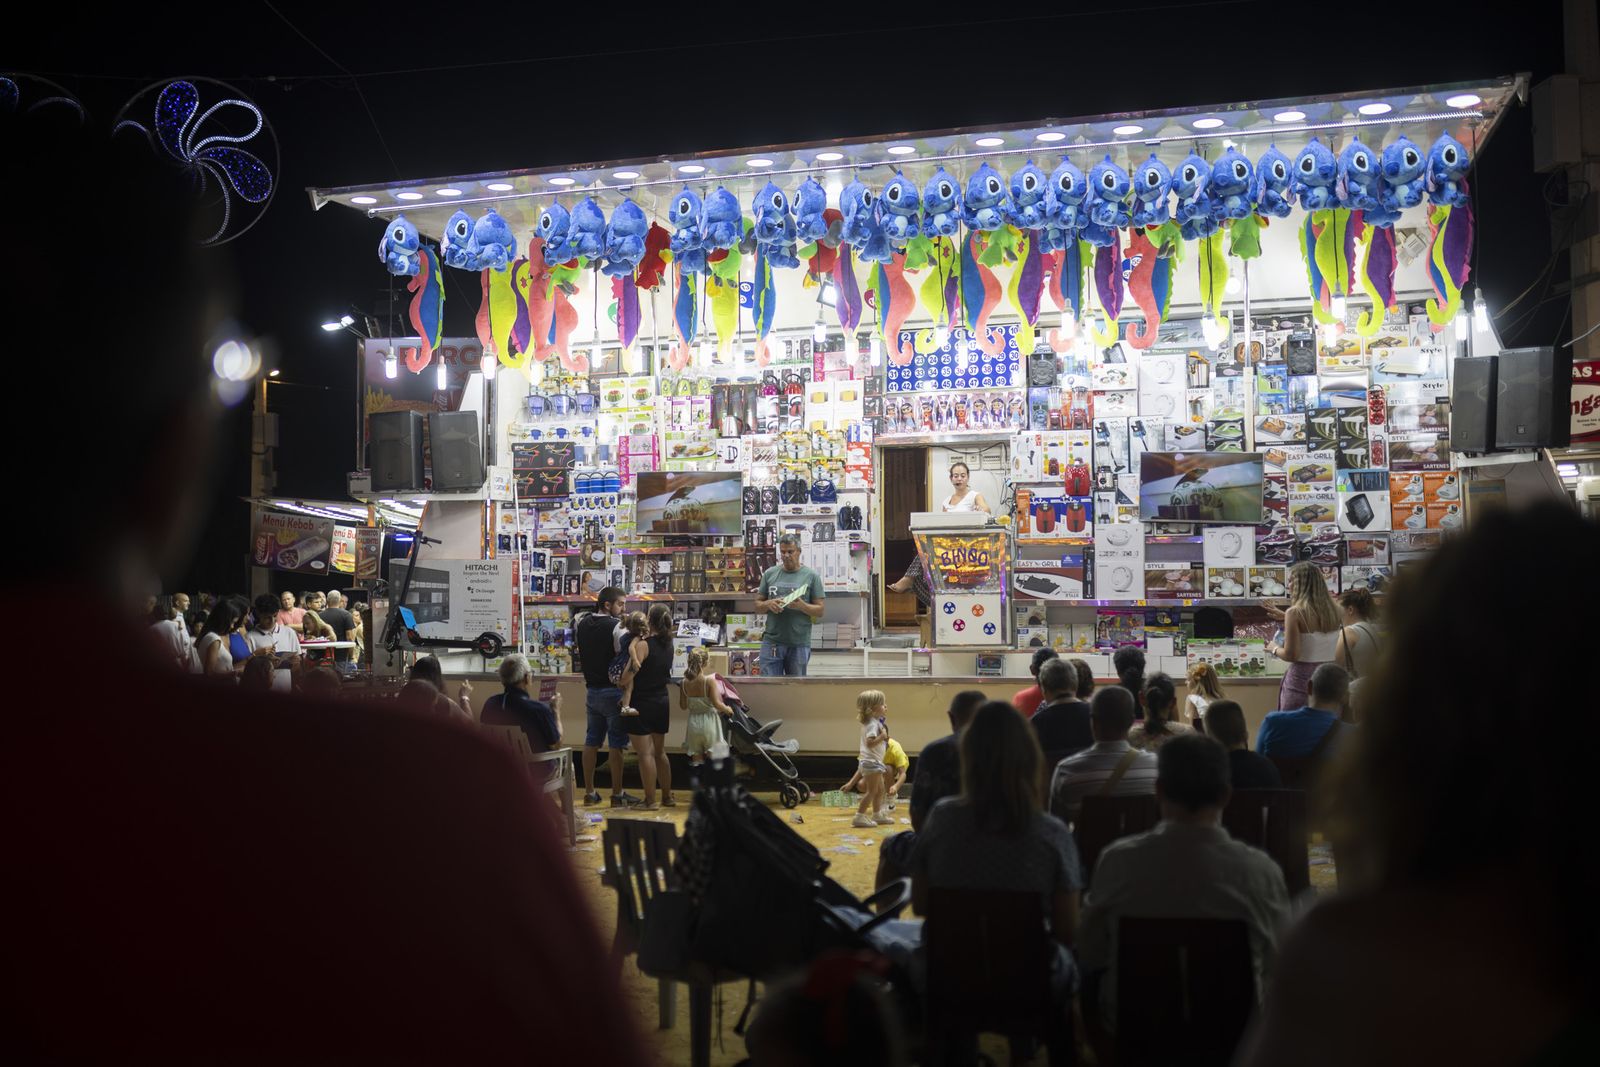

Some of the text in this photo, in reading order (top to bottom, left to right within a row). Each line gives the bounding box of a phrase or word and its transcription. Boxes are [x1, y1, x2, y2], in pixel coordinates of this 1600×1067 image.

[903, 333, 909, 341] 2
[943, 355, 950, 363] 25
[262, 514, 285, 527] Menú
[333, 529, 346, 537] enú
